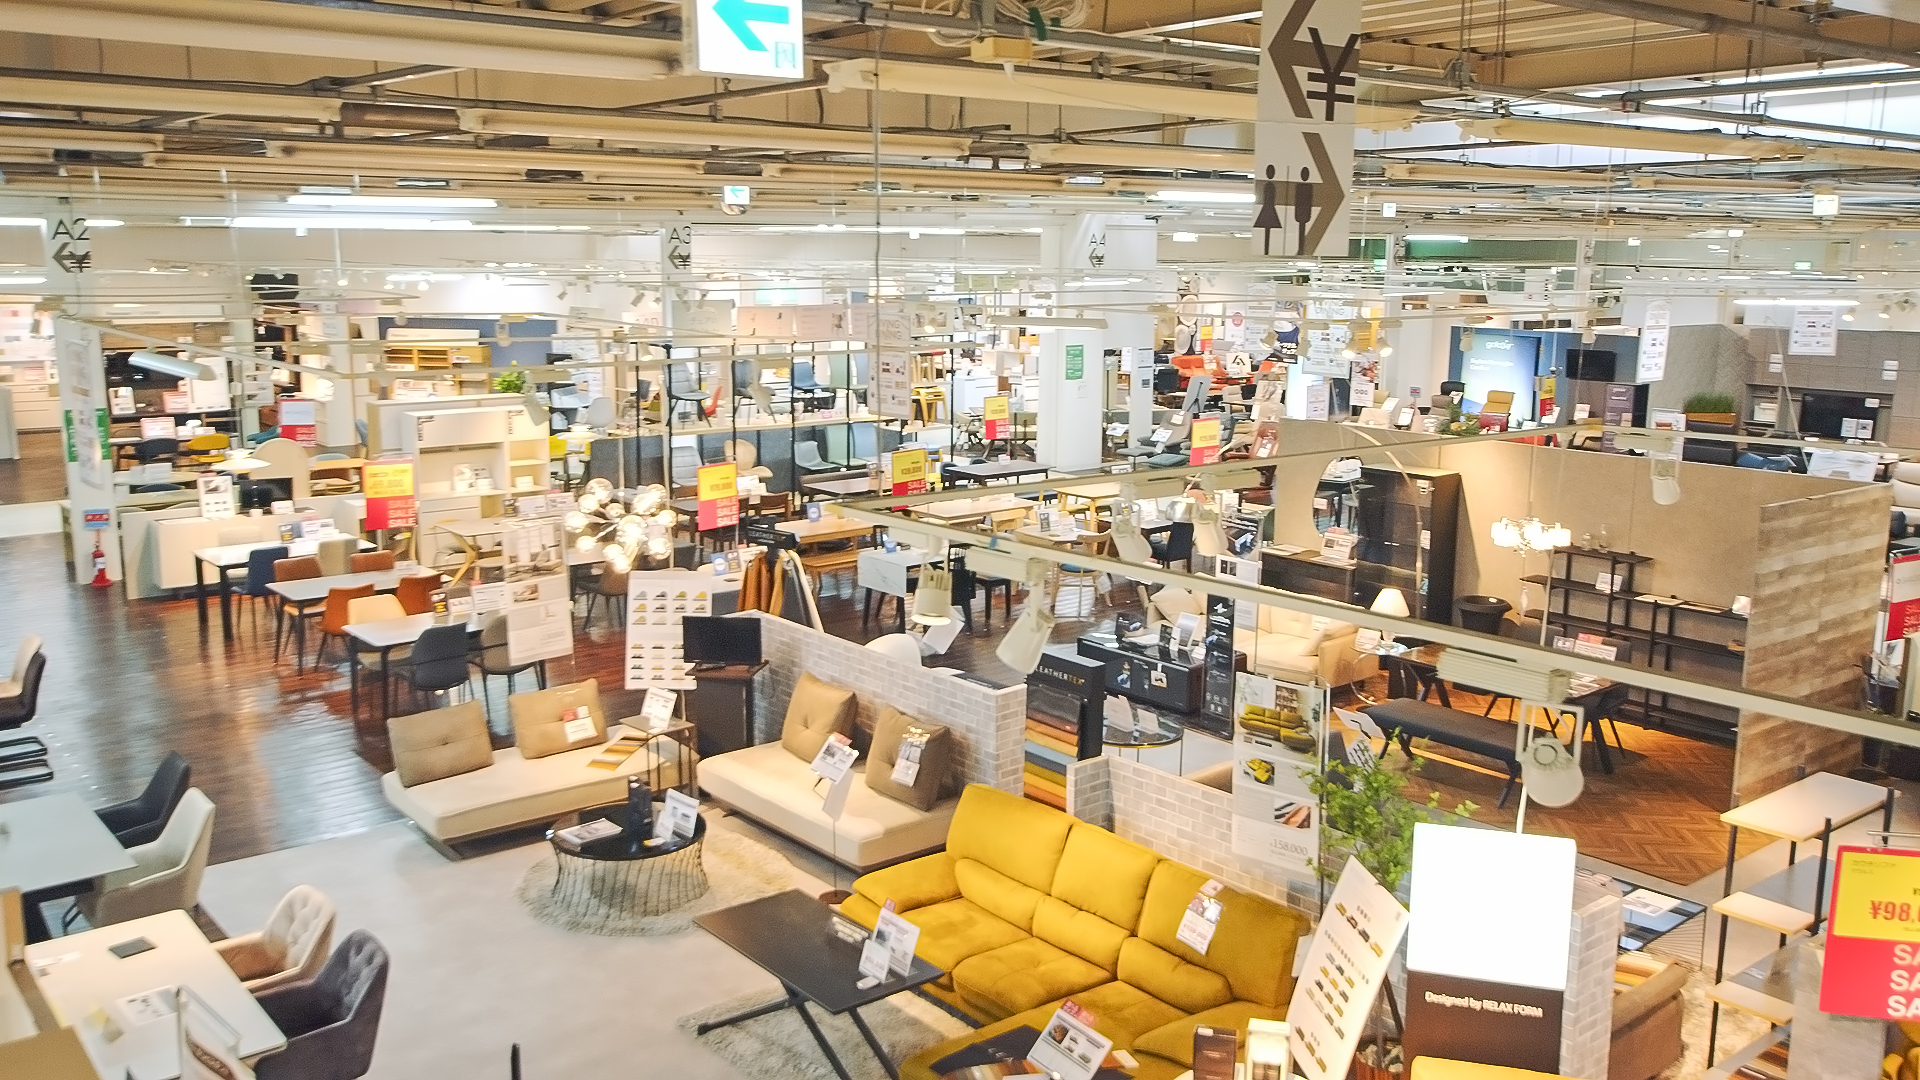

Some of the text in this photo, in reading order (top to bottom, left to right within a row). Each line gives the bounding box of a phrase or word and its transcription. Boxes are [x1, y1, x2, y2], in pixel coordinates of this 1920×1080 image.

[51, 217, 90, 241] A2
[668, 225, 691, 244] A3
[1088, 232, 1106, 247] A4
[907, 479, 926, 490] SALE
[388, 499, 416, 509] SALE
[717, 495, 739, 508] SALE
[388, 508, 417, 519] SALE
[717, 505, 739, 518] SALE
[387, 517, 418, 529] SALE
[717, 514, 740, 527] SALE
[1035, 665, 1086, 686] EATHERTEX
[1425, 990, 1543, 1018] Designed by RELAX FORM
